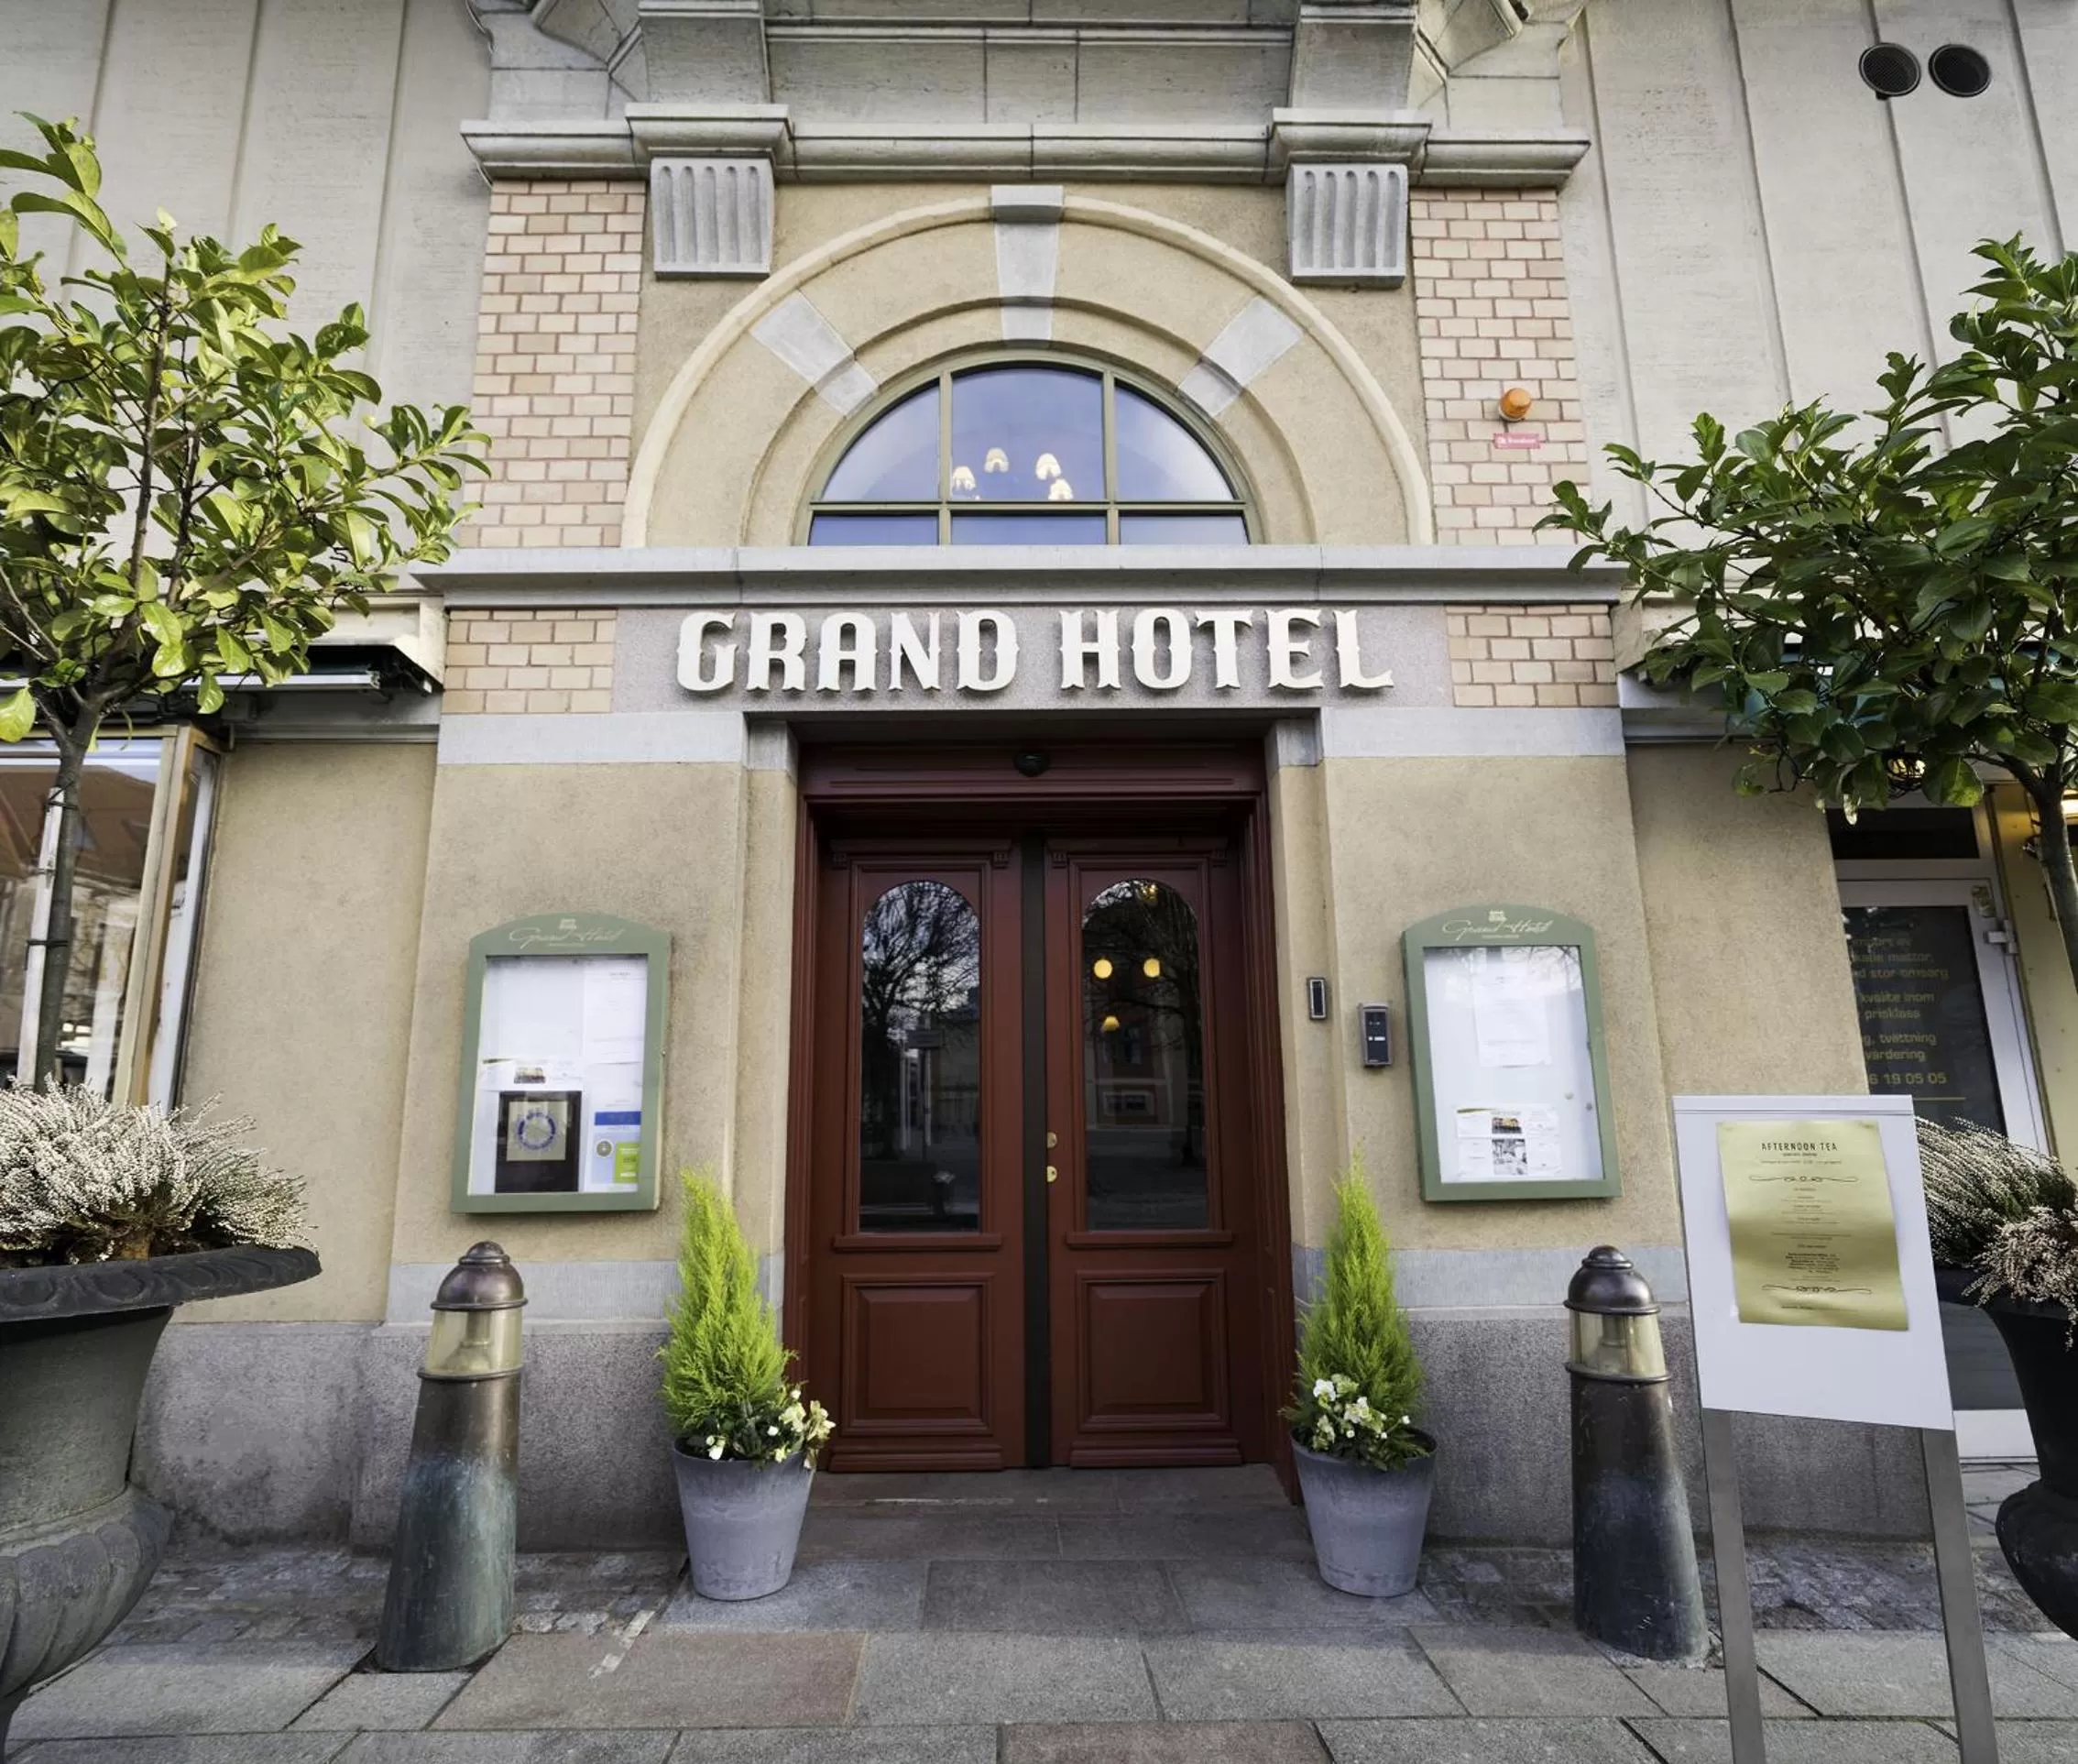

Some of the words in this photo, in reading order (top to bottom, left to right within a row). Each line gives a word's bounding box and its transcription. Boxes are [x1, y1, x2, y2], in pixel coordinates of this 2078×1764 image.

[676, 608, 1019, 693] GRAND
[1058, 607, 1395, 690] HOTEL
[1927, 1072, 1947, 1085] 05
[1761, 1142, 1816, 1151] AFTERNOON
[1820, 1142, 1838, 1151] TEA
